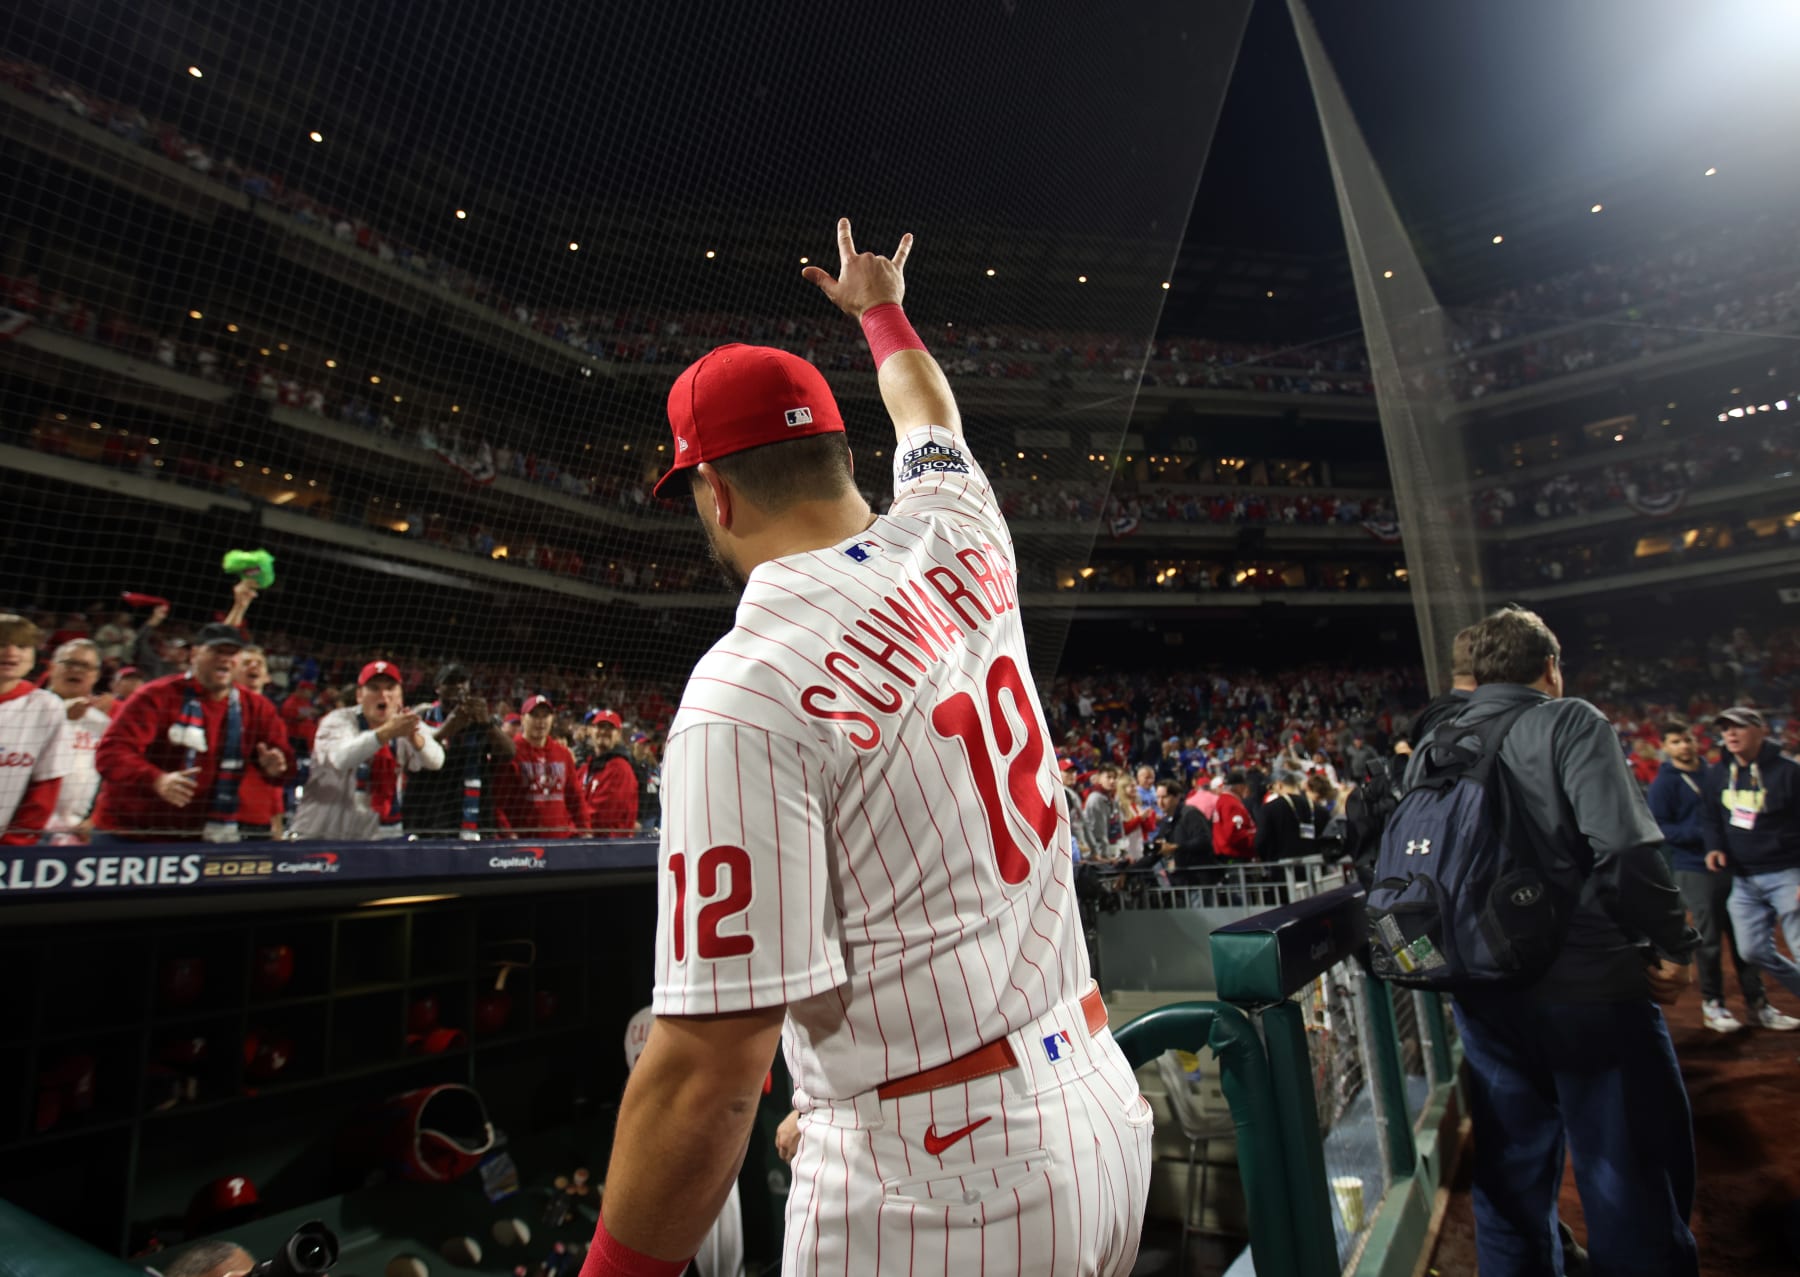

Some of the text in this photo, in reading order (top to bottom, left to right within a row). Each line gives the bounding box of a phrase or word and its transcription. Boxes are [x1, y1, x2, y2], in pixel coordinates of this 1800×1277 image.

[900, 446, 969, 481] WORLD SERIES
[932, 655, 1057, 884] 12
[71, 853, 201, 888] SERIES
[203, 861, 273, 876] 2022
[668, 845, 754, 962] 12
